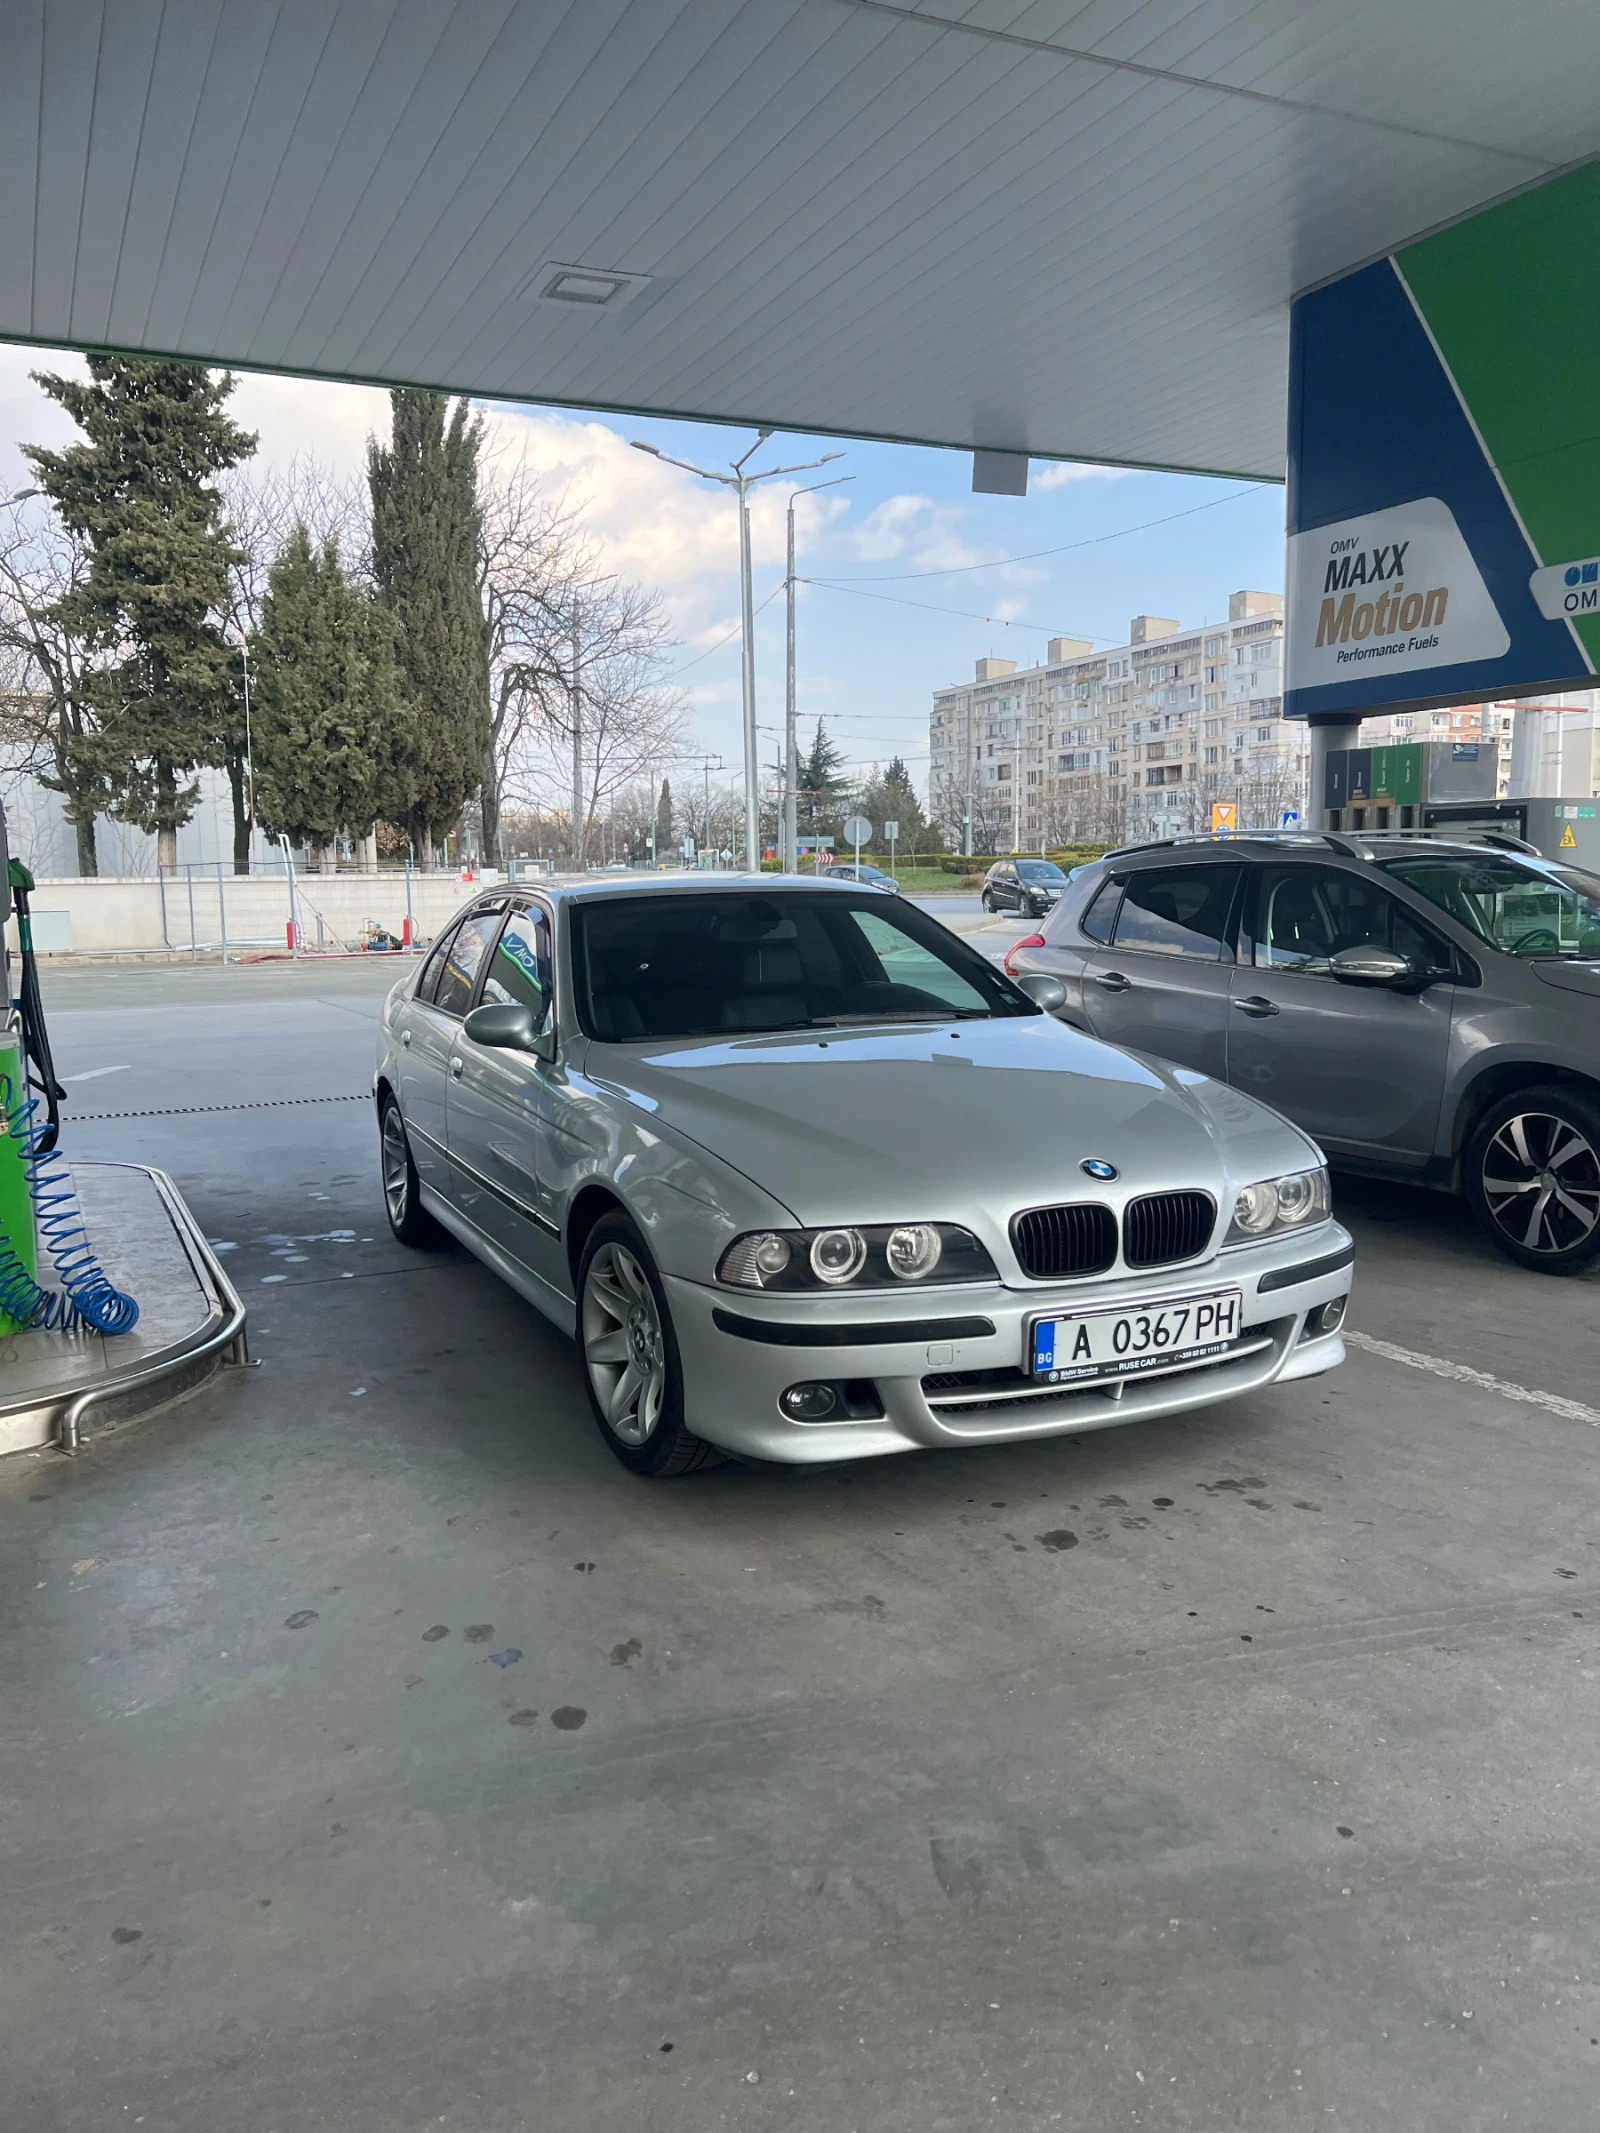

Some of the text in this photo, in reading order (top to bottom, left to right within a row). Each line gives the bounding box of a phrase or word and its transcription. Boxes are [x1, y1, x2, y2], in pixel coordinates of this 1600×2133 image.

[1330, 536, 1360, 554] OMV
[1323, 540, 1410, 593] MAXX
[1314, 582, 1449, 648] Motion
[1336, 634, 1439, 663] Performance Fuels
[1563, 835, 1573, 844] EX
[1072, 1300, 1235, 1361] A 0367 PH
[1037, 1352, 1052, 1364] BG
